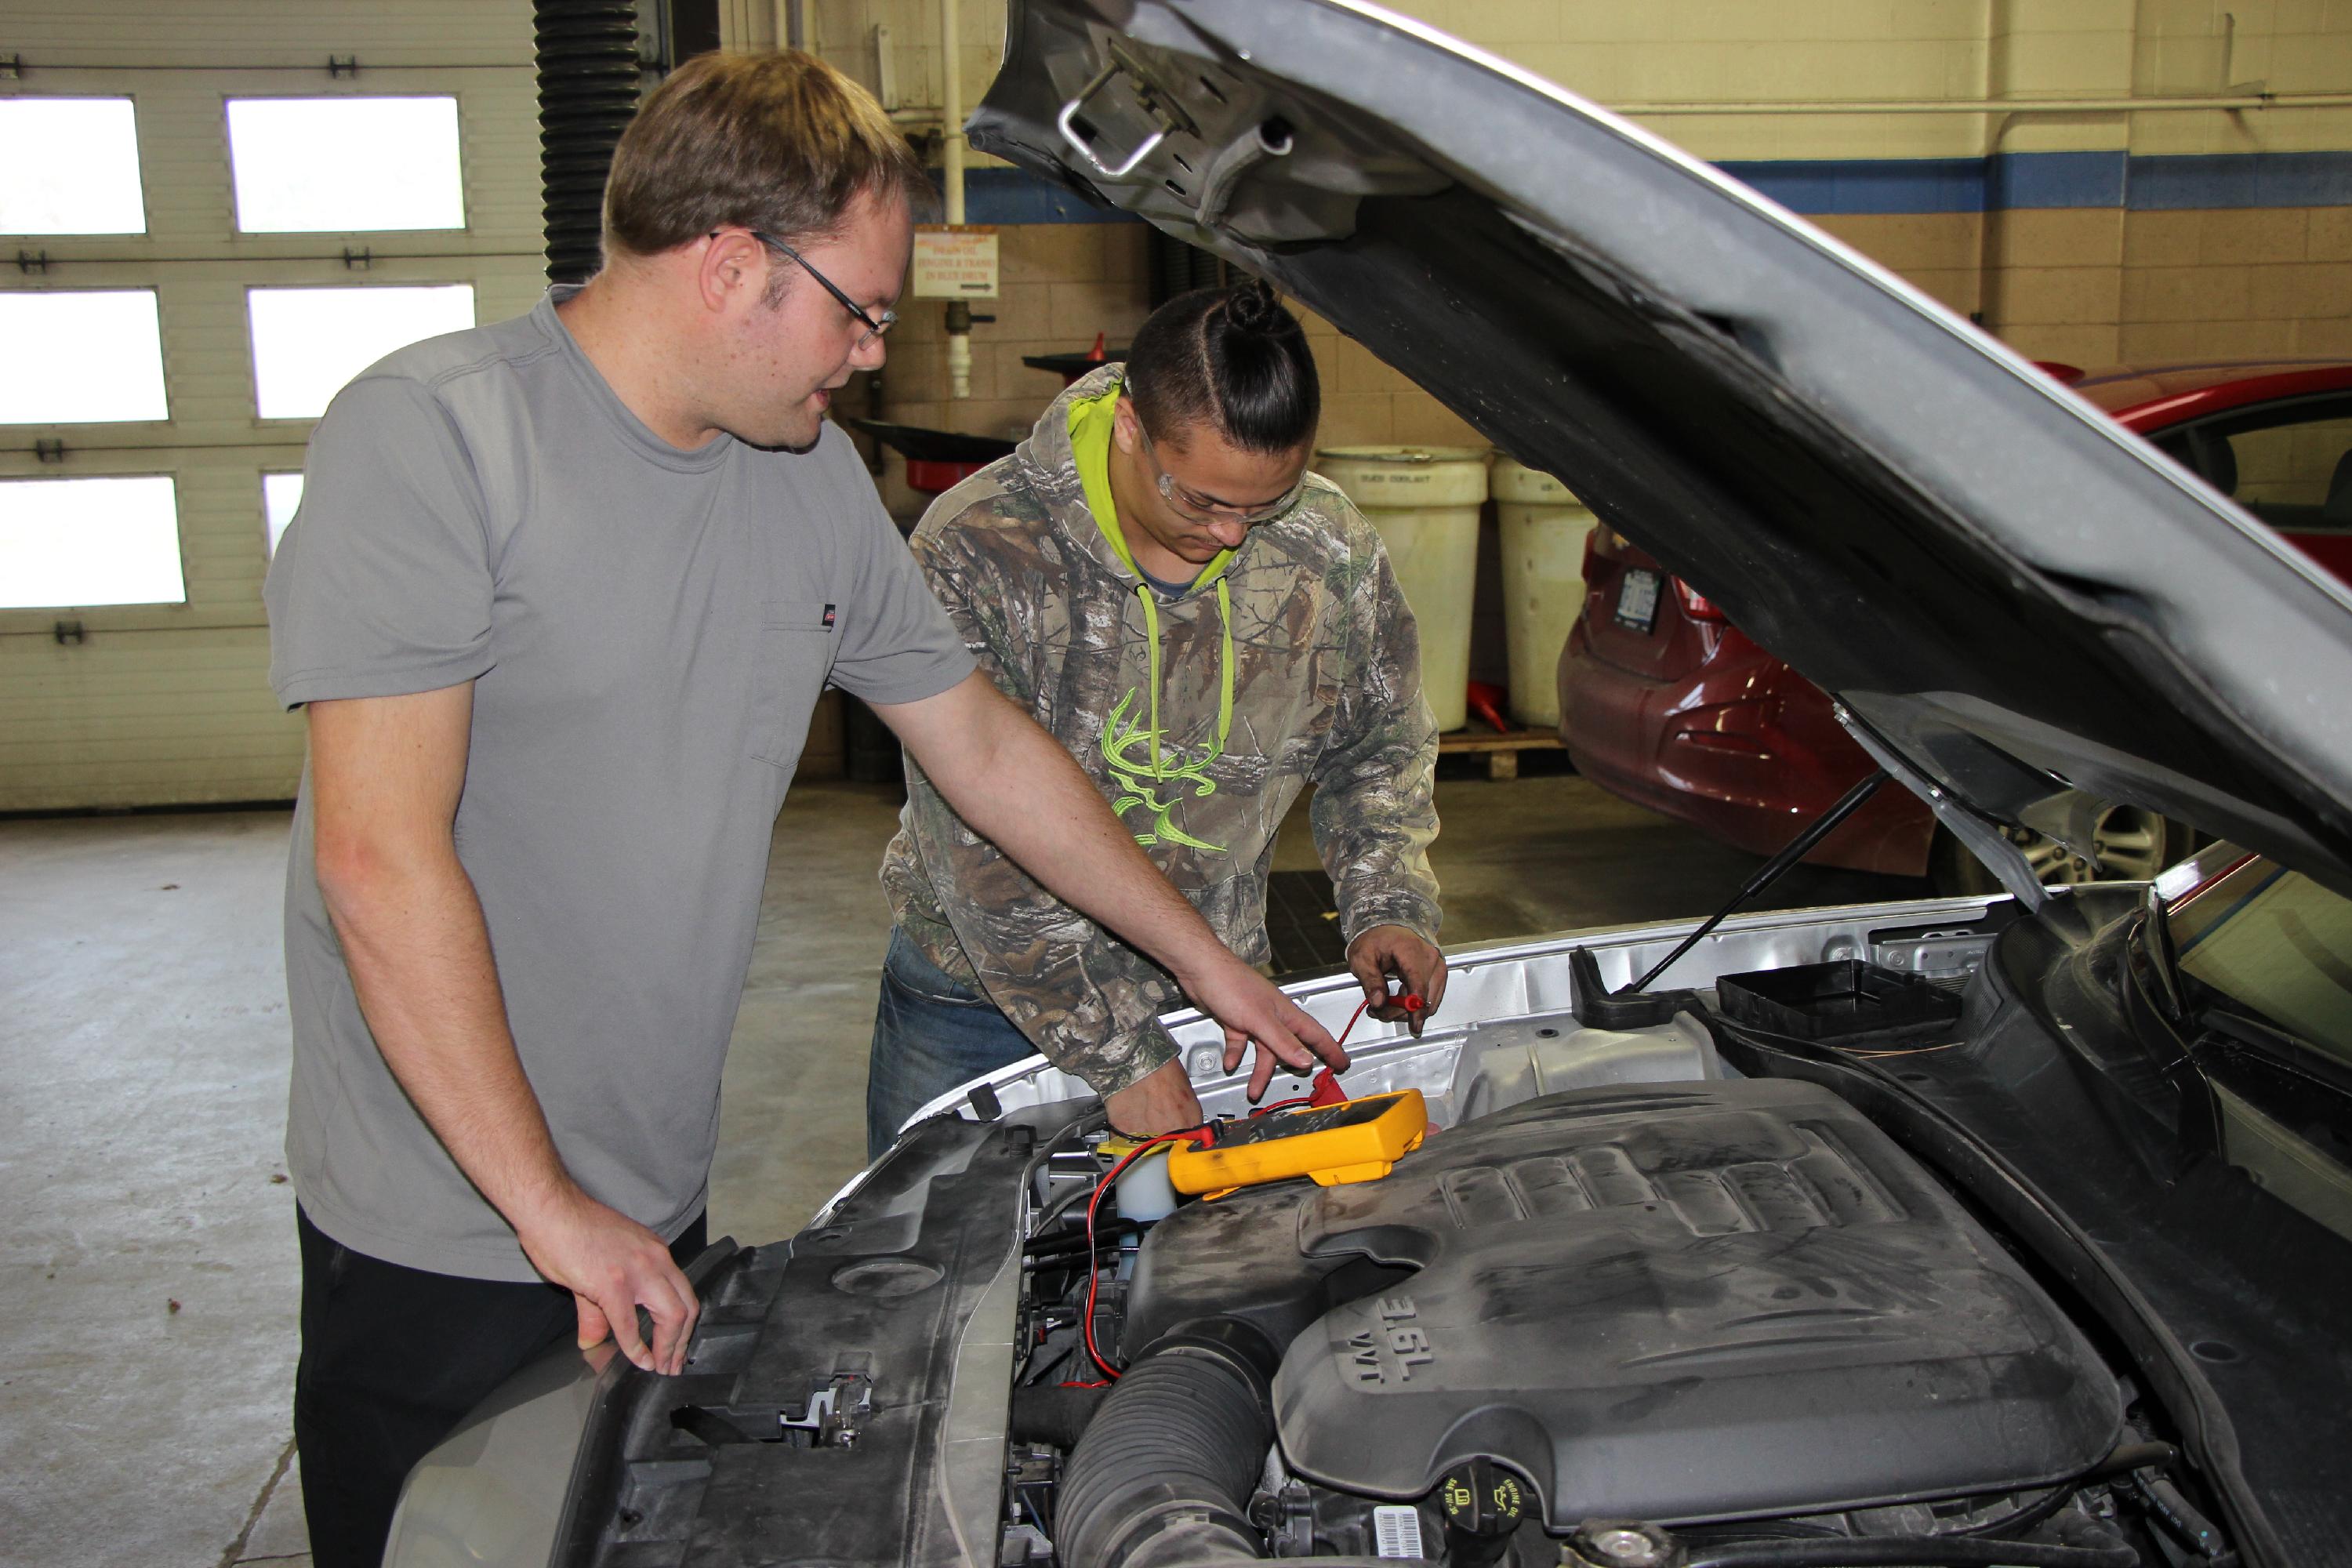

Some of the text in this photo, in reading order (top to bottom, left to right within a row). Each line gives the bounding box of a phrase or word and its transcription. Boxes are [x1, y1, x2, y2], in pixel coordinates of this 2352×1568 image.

[1390, 474, 1431, 483] COOLANT
[1348, 1330, 1385, 1384] VVT
[1375, 1295, 1435, 1381] 3.6L
[1445, 1478, 1457, 1491] SAE
[1503, 1479, 1521, 1519] ENGINE OIL
